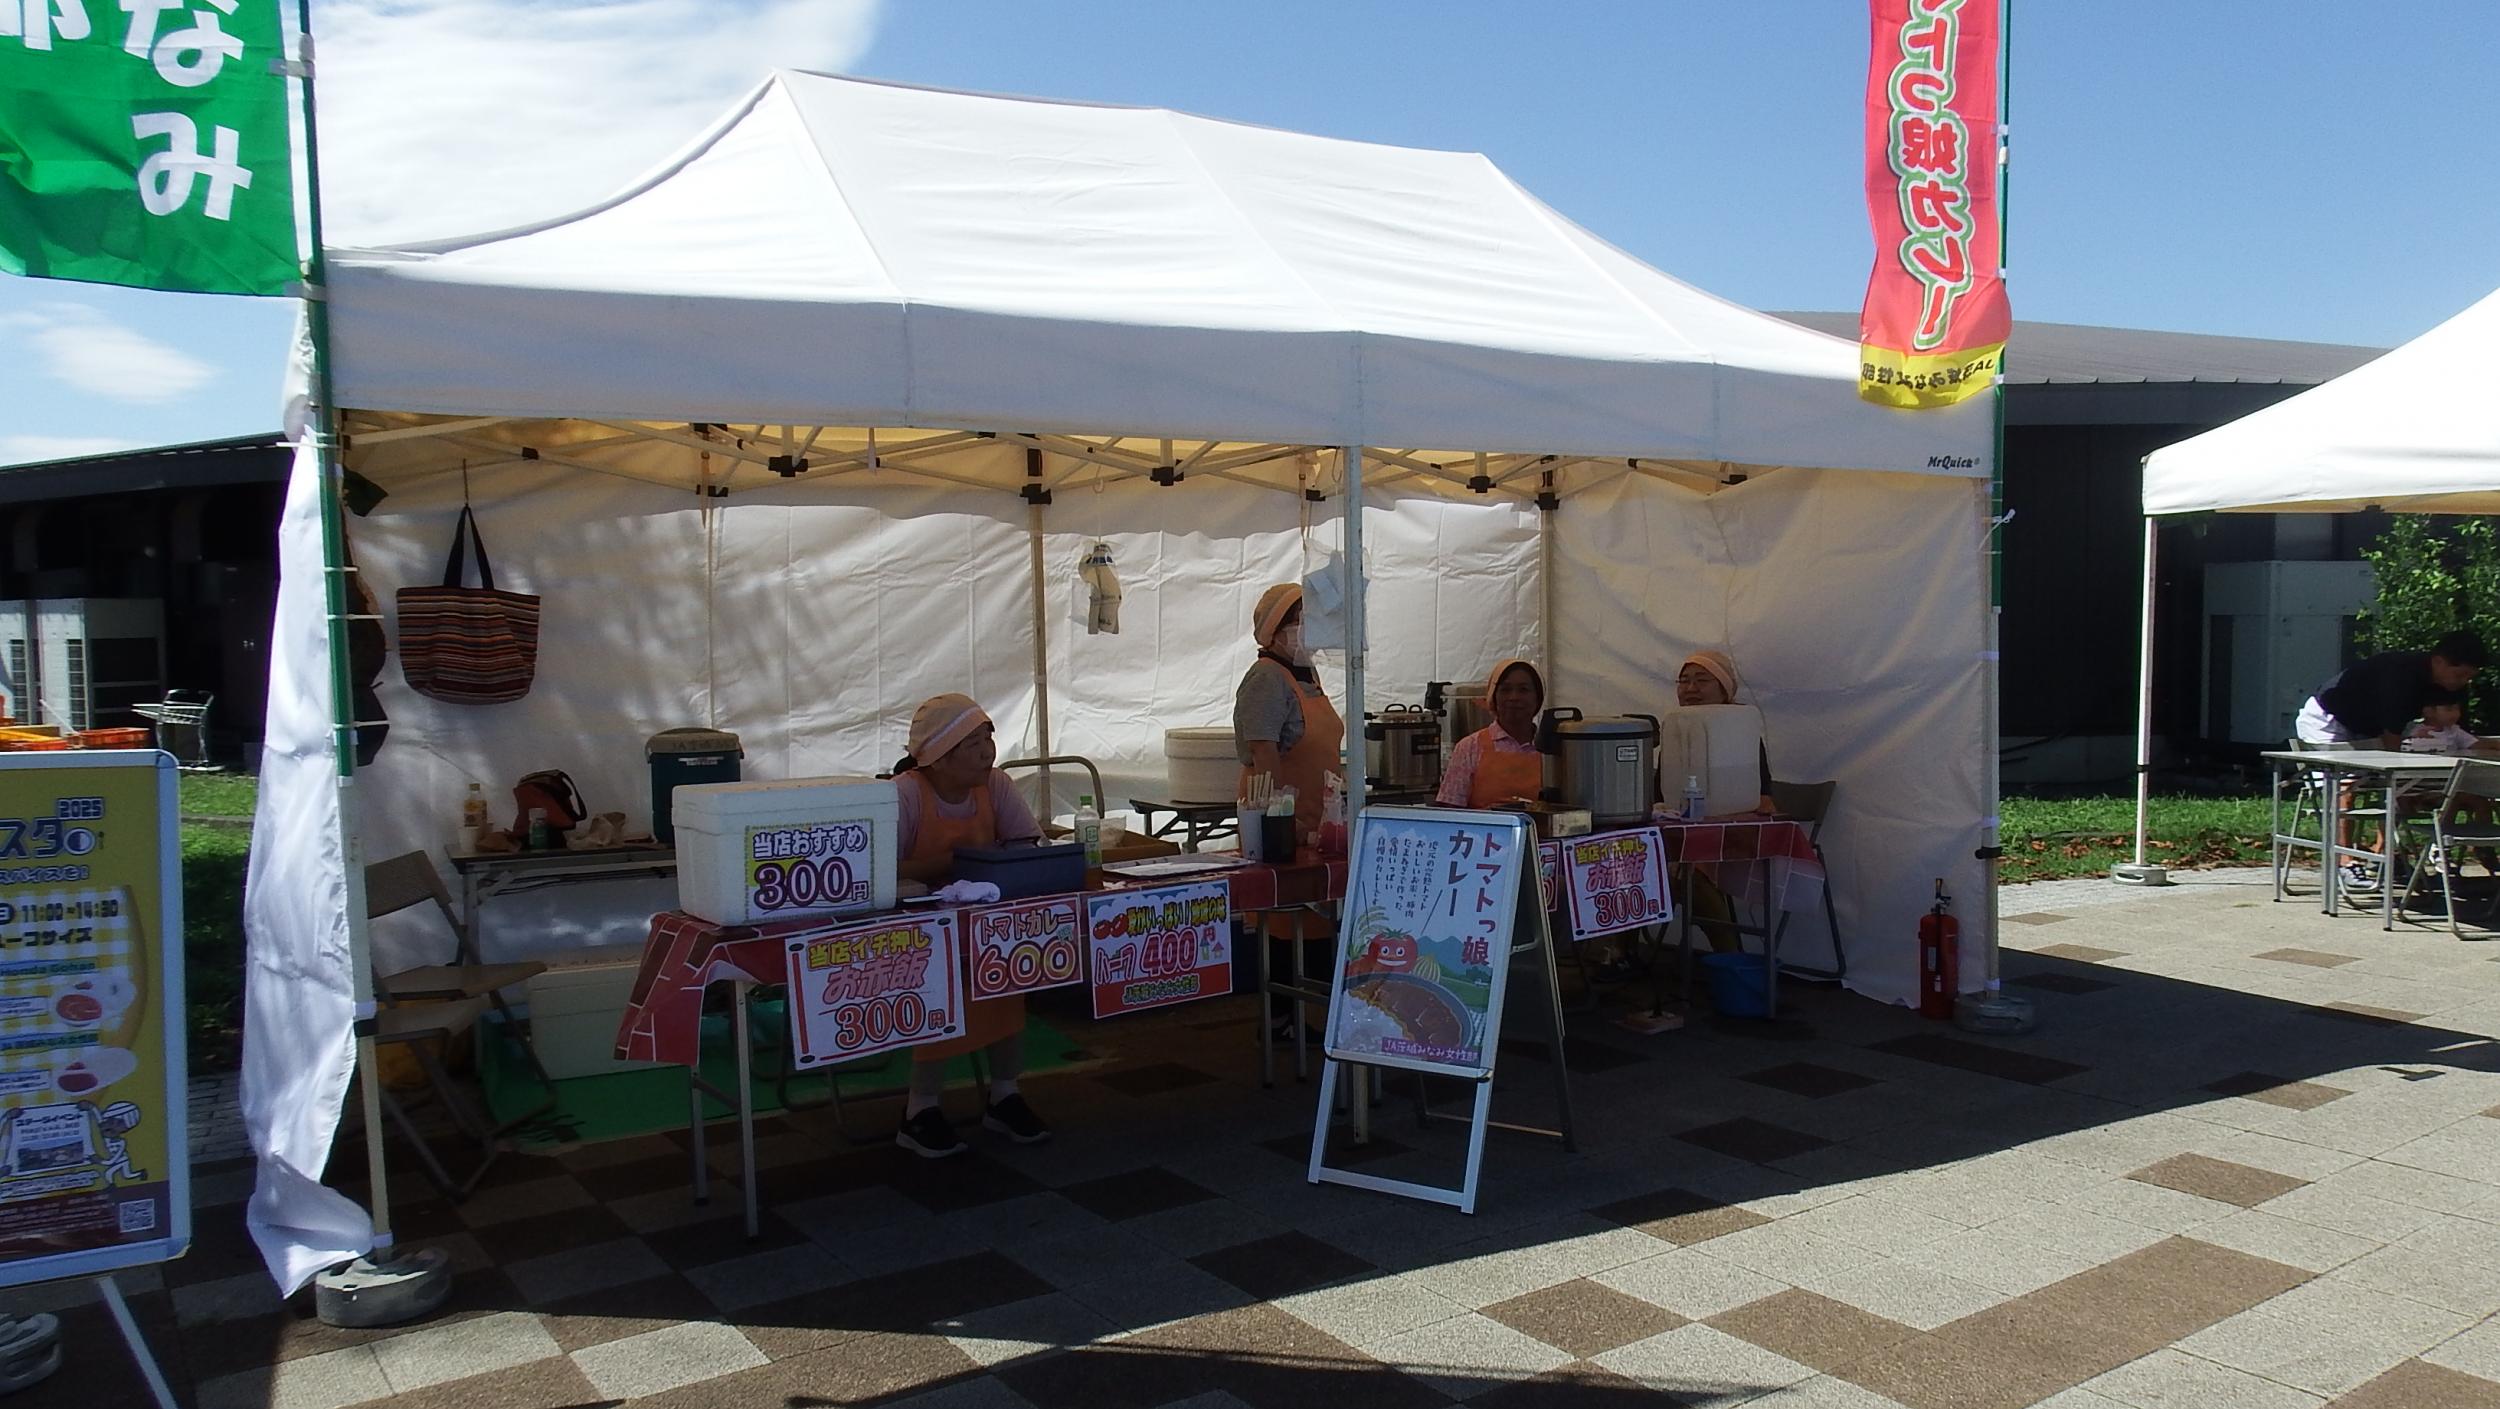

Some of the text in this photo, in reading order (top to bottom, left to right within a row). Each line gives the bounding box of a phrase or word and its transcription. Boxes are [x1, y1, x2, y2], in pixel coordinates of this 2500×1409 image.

[58, 799, 103, 819] 2025
[752, 826, 869, 860] 当店おすすめ
[1446, 829, 1474, 918] カレー
[1461, 831, 1503, 967] トマトっ娘
[807, 926, 932, 971] 当店イチ押し
[979, 907, 1077, 947] トマトカレー
[822, 948, 932, 1004] お赤飯
[1094, 943, 1136, 986] ハーフ
[1384, 1039, 1479, 1062] JA茨城みなみ女性部
